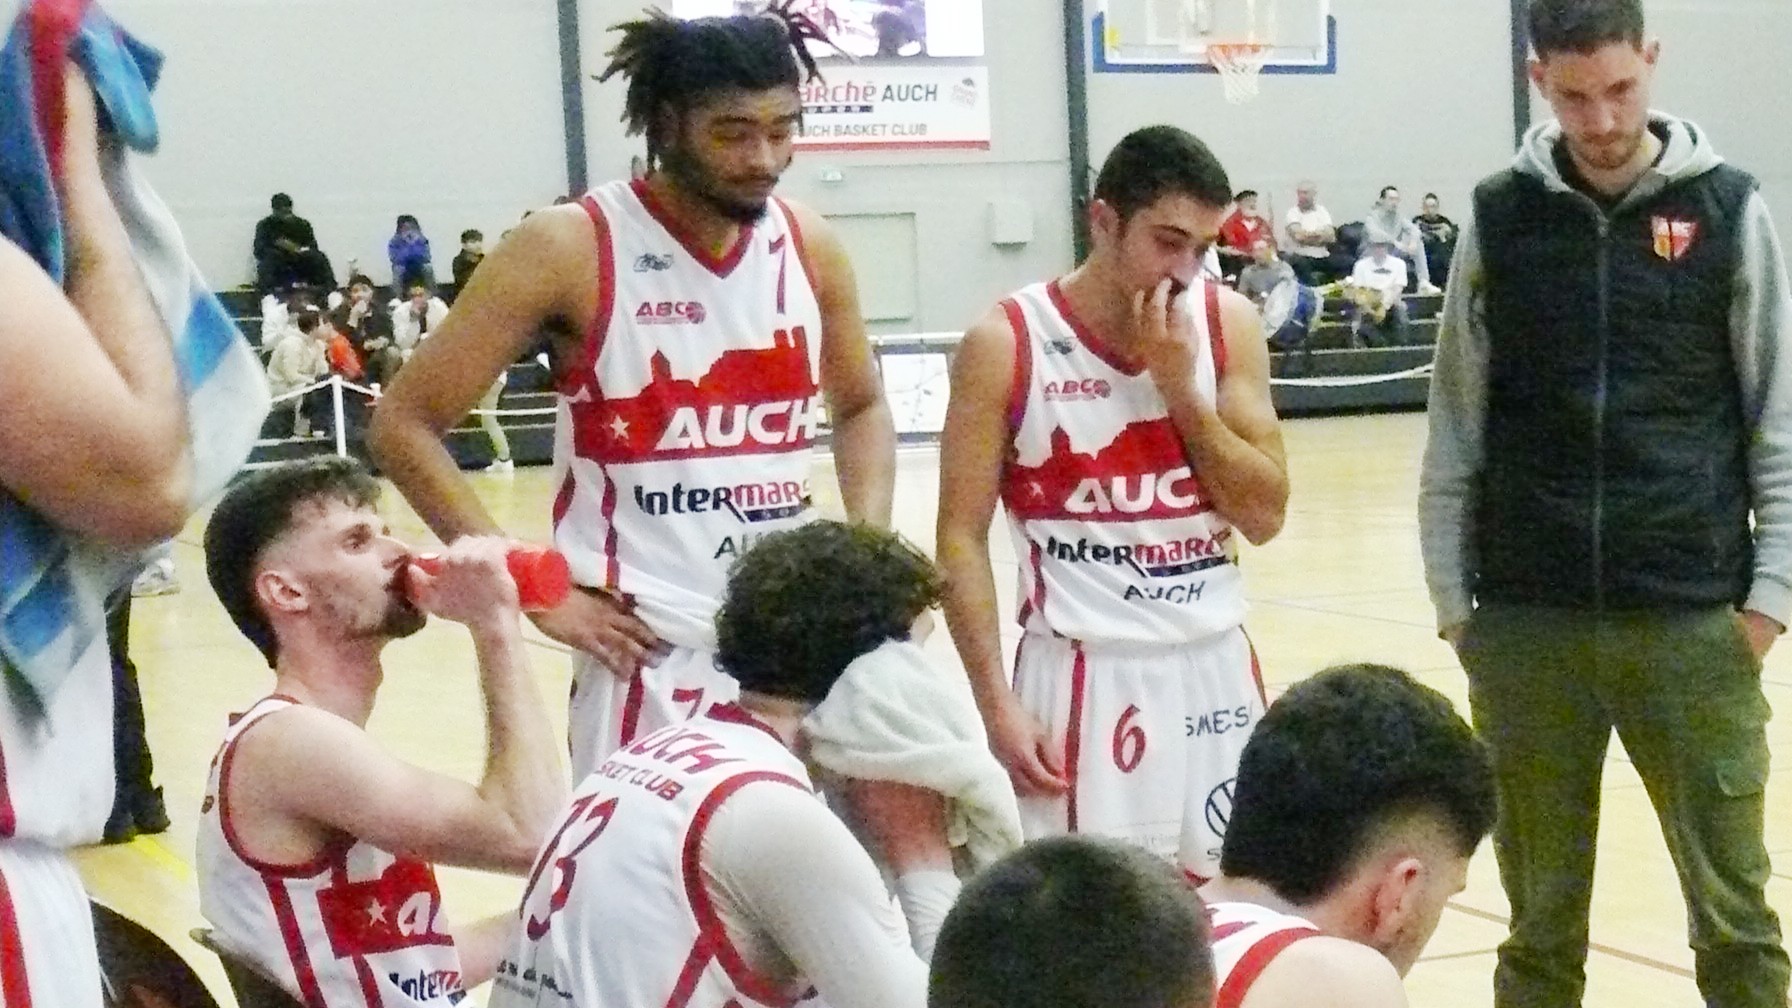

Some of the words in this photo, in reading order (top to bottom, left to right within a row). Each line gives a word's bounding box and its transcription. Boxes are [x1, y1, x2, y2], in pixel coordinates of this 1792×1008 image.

[881, 84, 938, 102] AUCH
[834, 124, 887, 137] BASKET
[891, 123, 928, 136] CLUB
[769, 233, 786, 315] 7
[636, 301, 687, 317] ABC
[1064, 467, 1199, 514] AUC
[1124, 581, 1207, 604] AUCH
[619, 728, 747, 774] UCH
[1113, 703, 1147, 773] 6
[630, 768, 685, 801] CLUB
